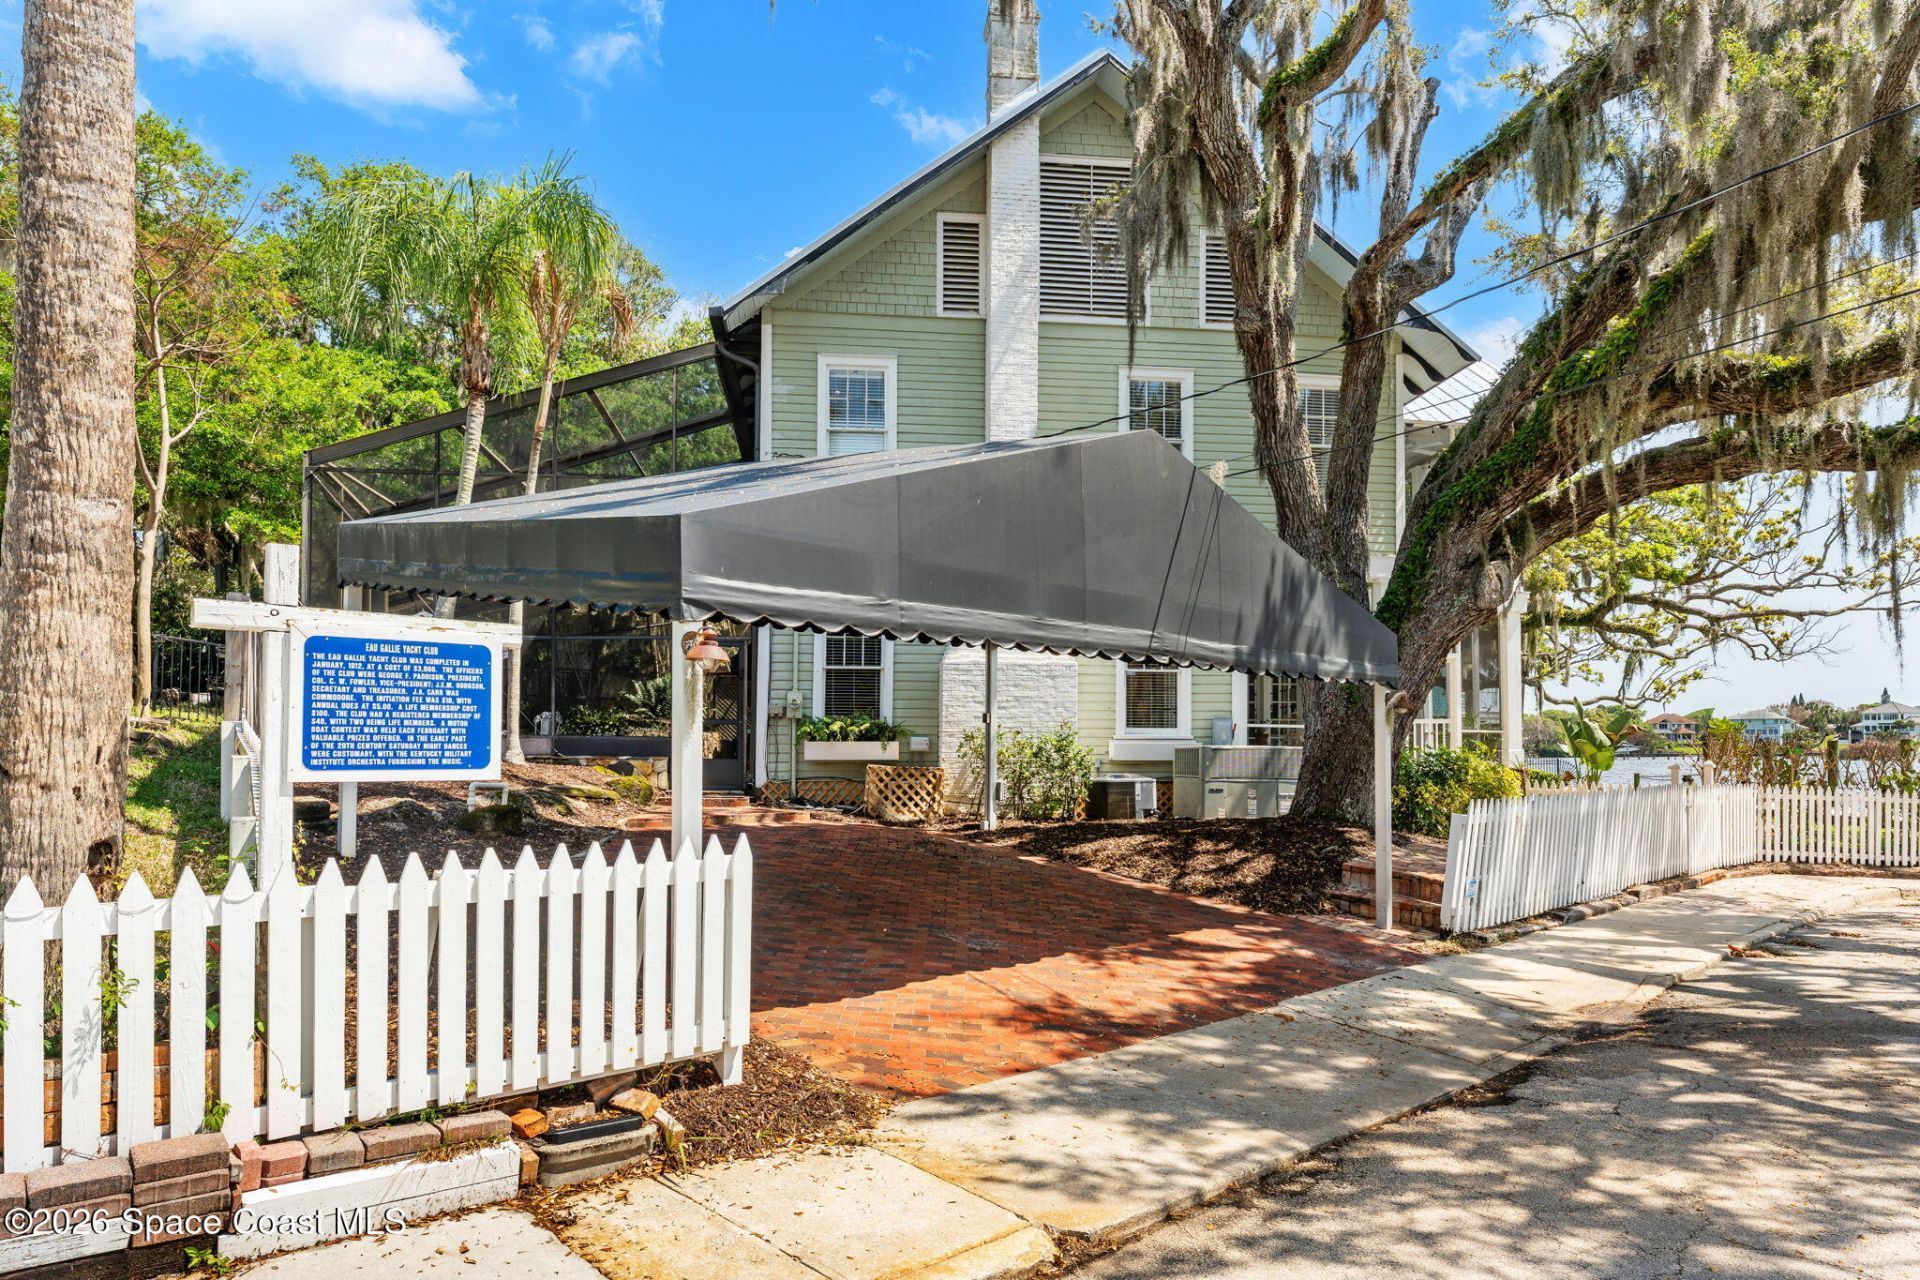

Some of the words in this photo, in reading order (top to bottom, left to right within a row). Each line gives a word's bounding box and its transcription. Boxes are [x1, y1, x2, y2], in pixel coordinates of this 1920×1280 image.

[365, 643, 377, 652] EAU
[380, 644, 400, 653] GALLIE
[402, 645, 421, 654] YACHT
[423, 646, 438, 655] CLUB
